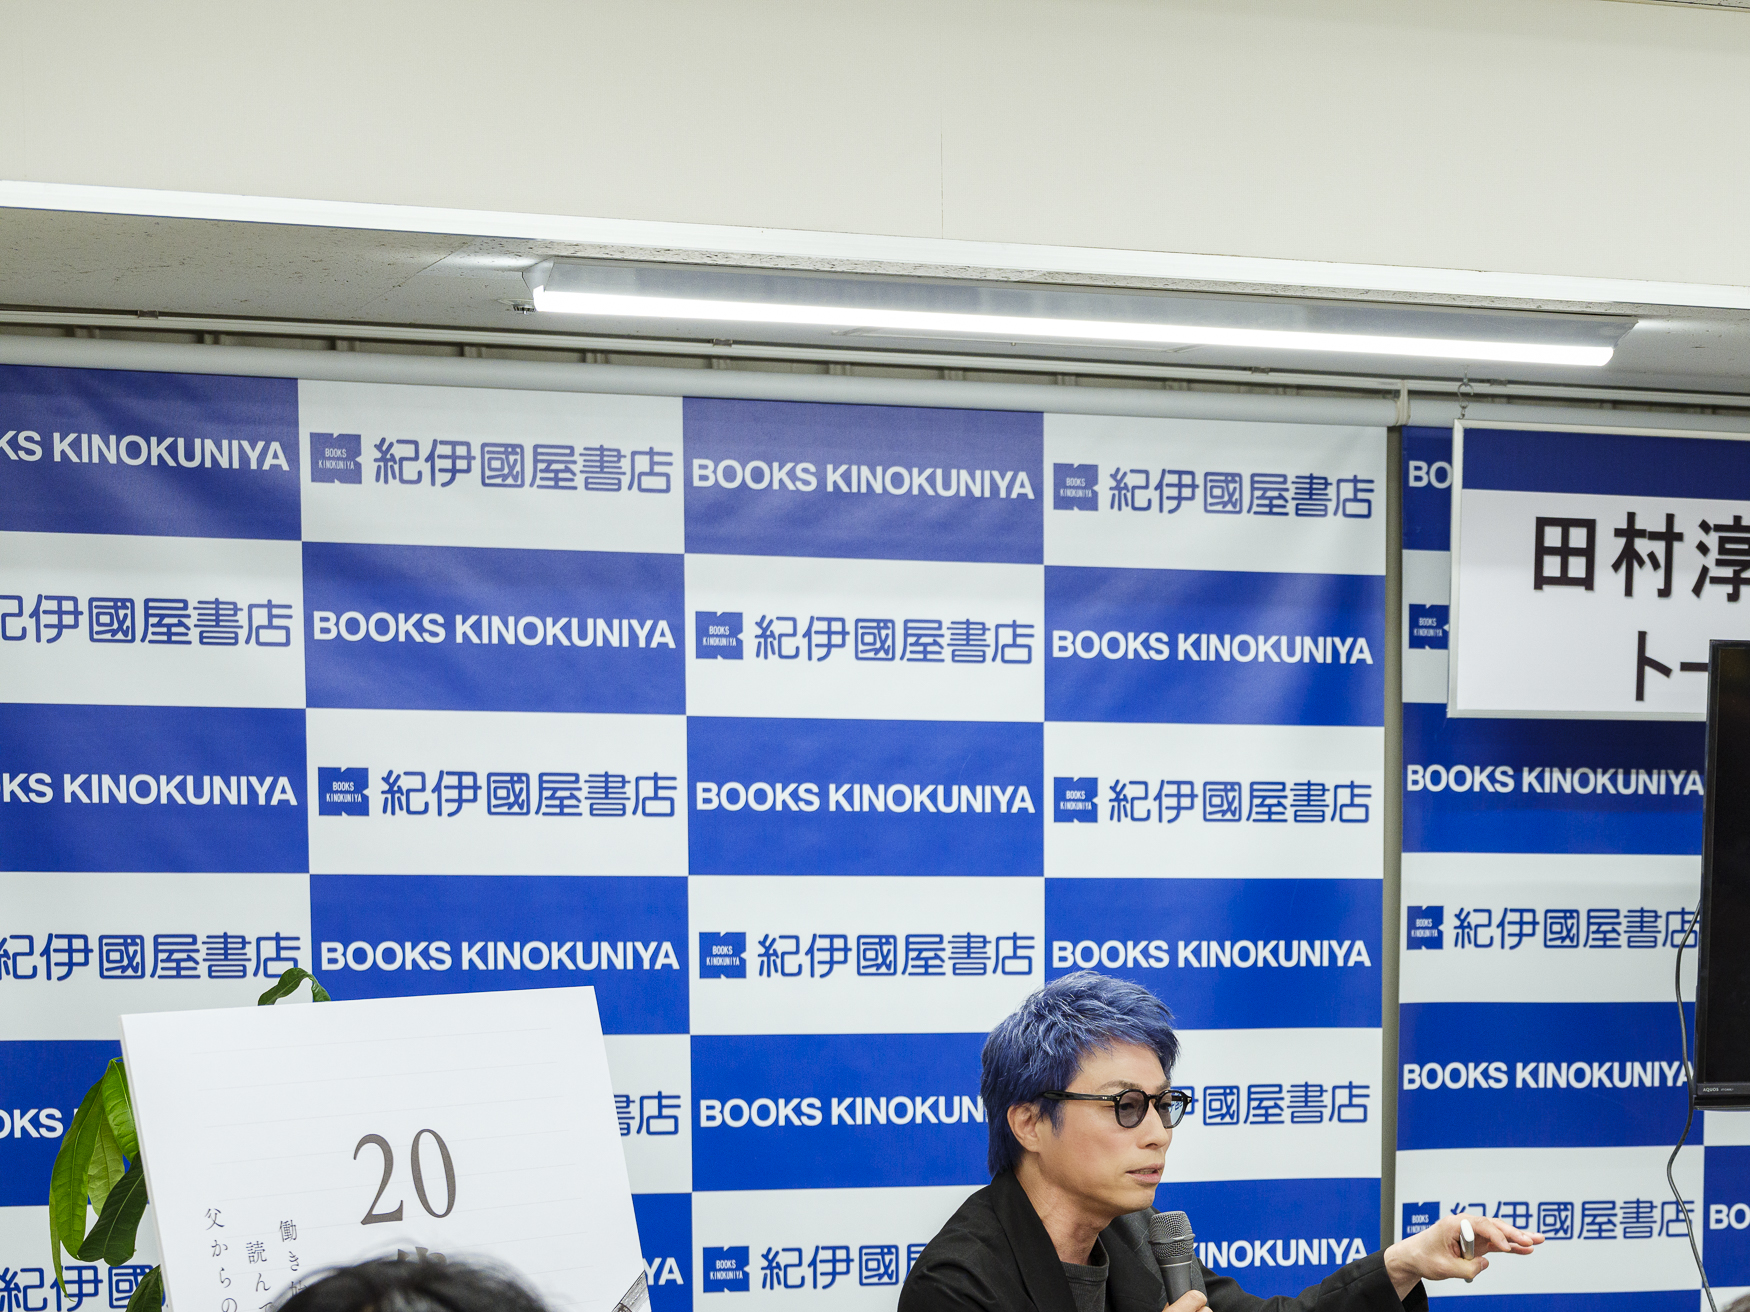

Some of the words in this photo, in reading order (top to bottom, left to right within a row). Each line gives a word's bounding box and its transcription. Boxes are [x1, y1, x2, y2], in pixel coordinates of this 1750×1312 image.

[53, 433, 290, 471] KINOKUNIYA
[325, 448, 346, 458] BOOKS
[374, 437, 673, 493] 紀伊國屋書店
[693, 459, 817, 491] BOOKS
[827, 464, 1034, 499] KINOKUNIYA
[1066, 478, 1085, 486] BOOKS
[1109, 468, 1374, 519] 紀伊國屋書店
[314, 611, 445, 643] BOOKS
[456, 615, 676, 648] KINOKUNIYA
[709, 629, 729, 639] BOOKS
[1419, 618, 1436, 626] BOOKS
[755, 615, 1034, 664] 紀伊國屋書店
[1053, 630, 1169, 660] BOOKS
[1178, 633, 1373, 664] KINOKUNIYA
[64, 774, 297, 805] KINOKUNIYA
[333, 782, 354, 791] BOOKS
[381, 770, 677, 817] 紀伊國屋書店
[1066, 790, 1085, 799] BOOKS
[1407, 765, 1514, 792] BOOKS
[1523, 767, 1704, 795] KINOKUNIYA
[697, 782, 820, 811] BOOKS
[829, 784, 1035, 813] KINOKUNIYA
[1109, 780, 1371, 823] 紀伊國屋書店
[1416, 919, 1432, 927] BOOKS
[1454, 906, 1697, 949] 紀伊國屋書店
[321, 941, 452, 971] BOOKS
[462, 941, 679, 970] KINOKUNIYA
[713, 946, 732, 954] BOOKS
[758, 932, 1034, 978] 紀伊國屋書店
[1053, 940, 1169, 968] BOOKS
[1178, 940, 1371, 968] KINOKUNIYA
[1403, 1062, 1508, 1090] BOOKS
[1516, 1061, 1692, 1088] KINOKUNIYA
[700, 1097, 822, 1127] BOOKS
[353, 1128, 457, 1226] 20
[716, 1260, 736, 1269] BOOKS
[1190, 1240, 1366, 1268] INOKUNIYA
